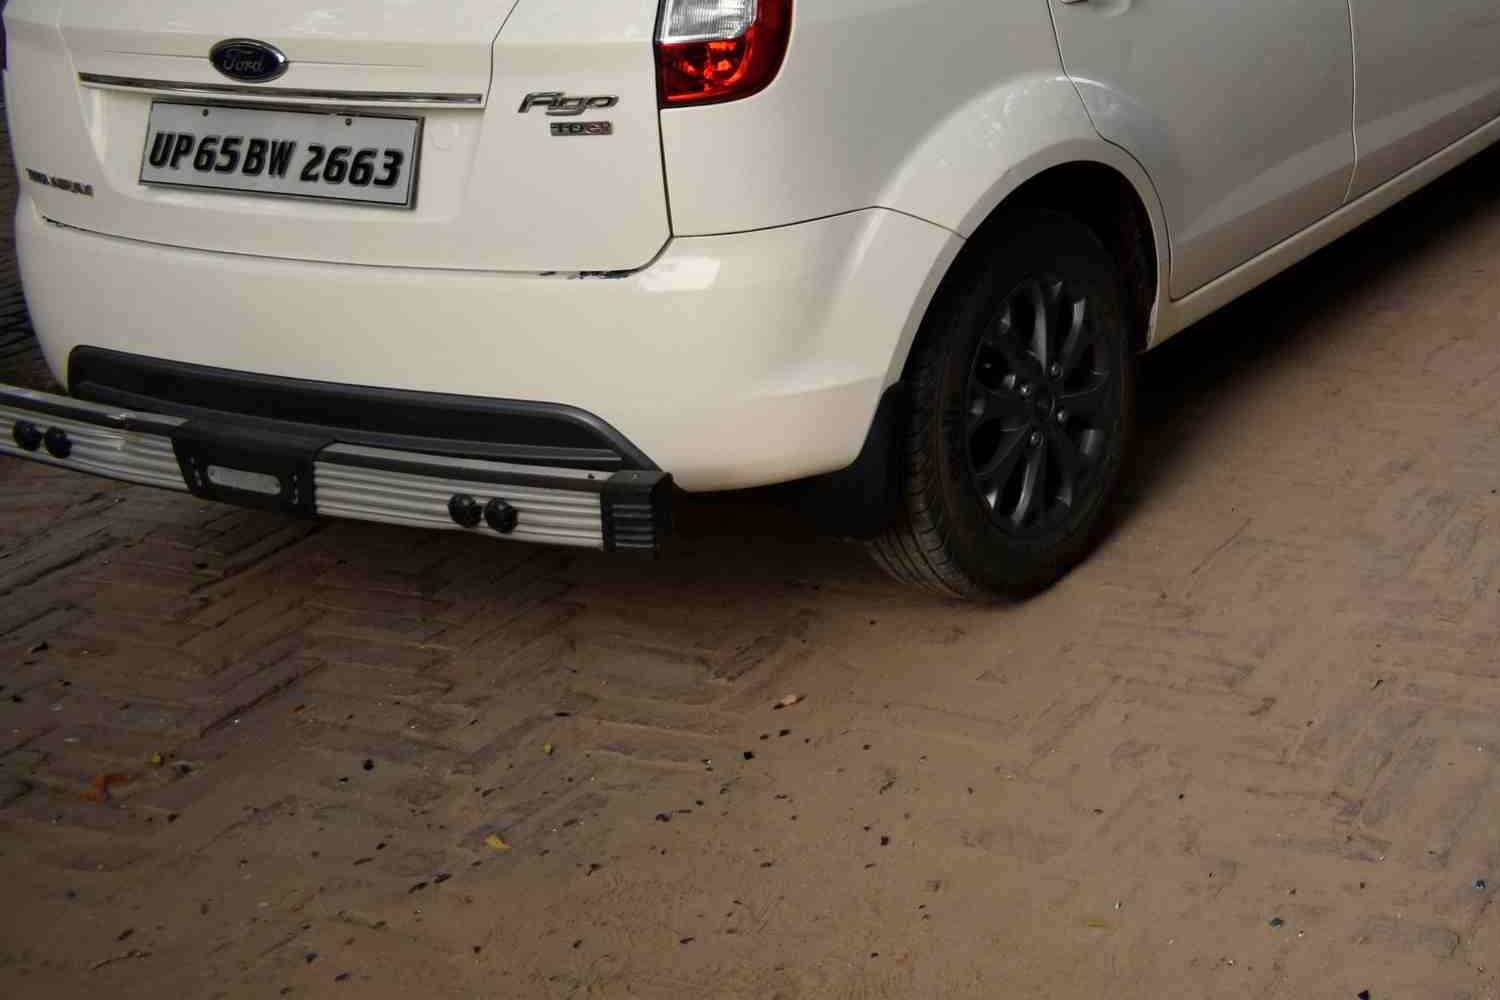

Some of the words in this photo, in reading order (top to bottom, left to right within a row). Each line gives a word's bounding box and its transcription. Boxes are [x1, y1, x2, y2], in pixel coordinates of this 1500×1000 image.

[222, 48, 266, 73] Ford
[518, 91, 619, 117] Figo
[300, 143, 405, 187] 2663
